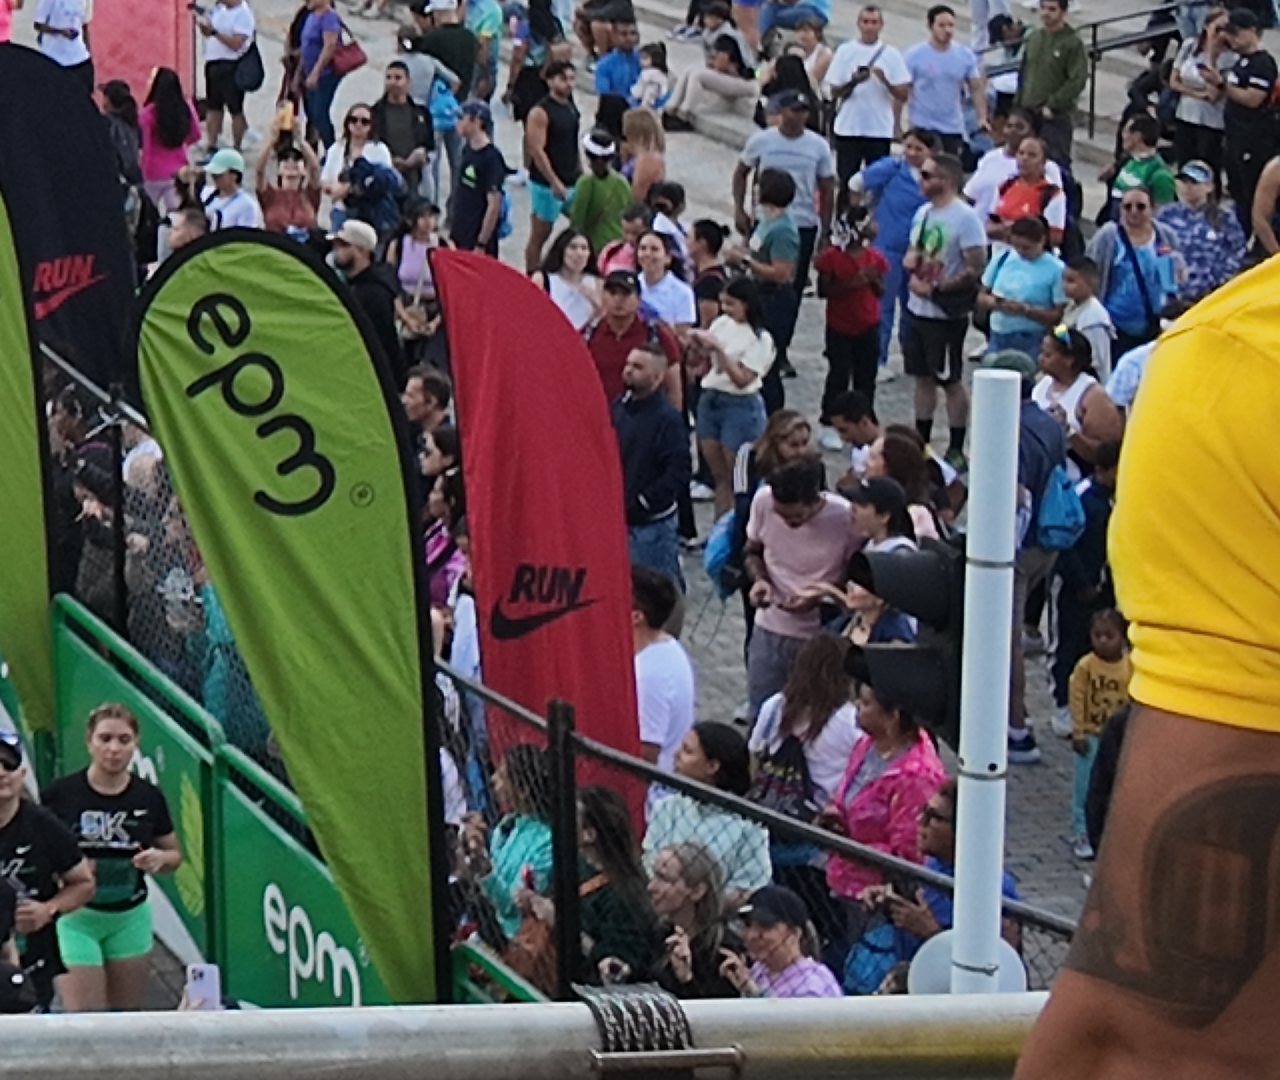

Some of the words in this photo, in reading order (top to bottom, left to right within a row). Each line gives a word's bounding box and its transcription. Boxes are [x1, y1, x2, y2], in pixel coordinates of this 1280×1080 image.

[34, 254, 95, 293] RUN
[184, 292, 336, 517] epm
[509, 563, 589, 605] RUN
[81, 810, 130, 842] 5K
[263, 883, 362, 1007] epm
